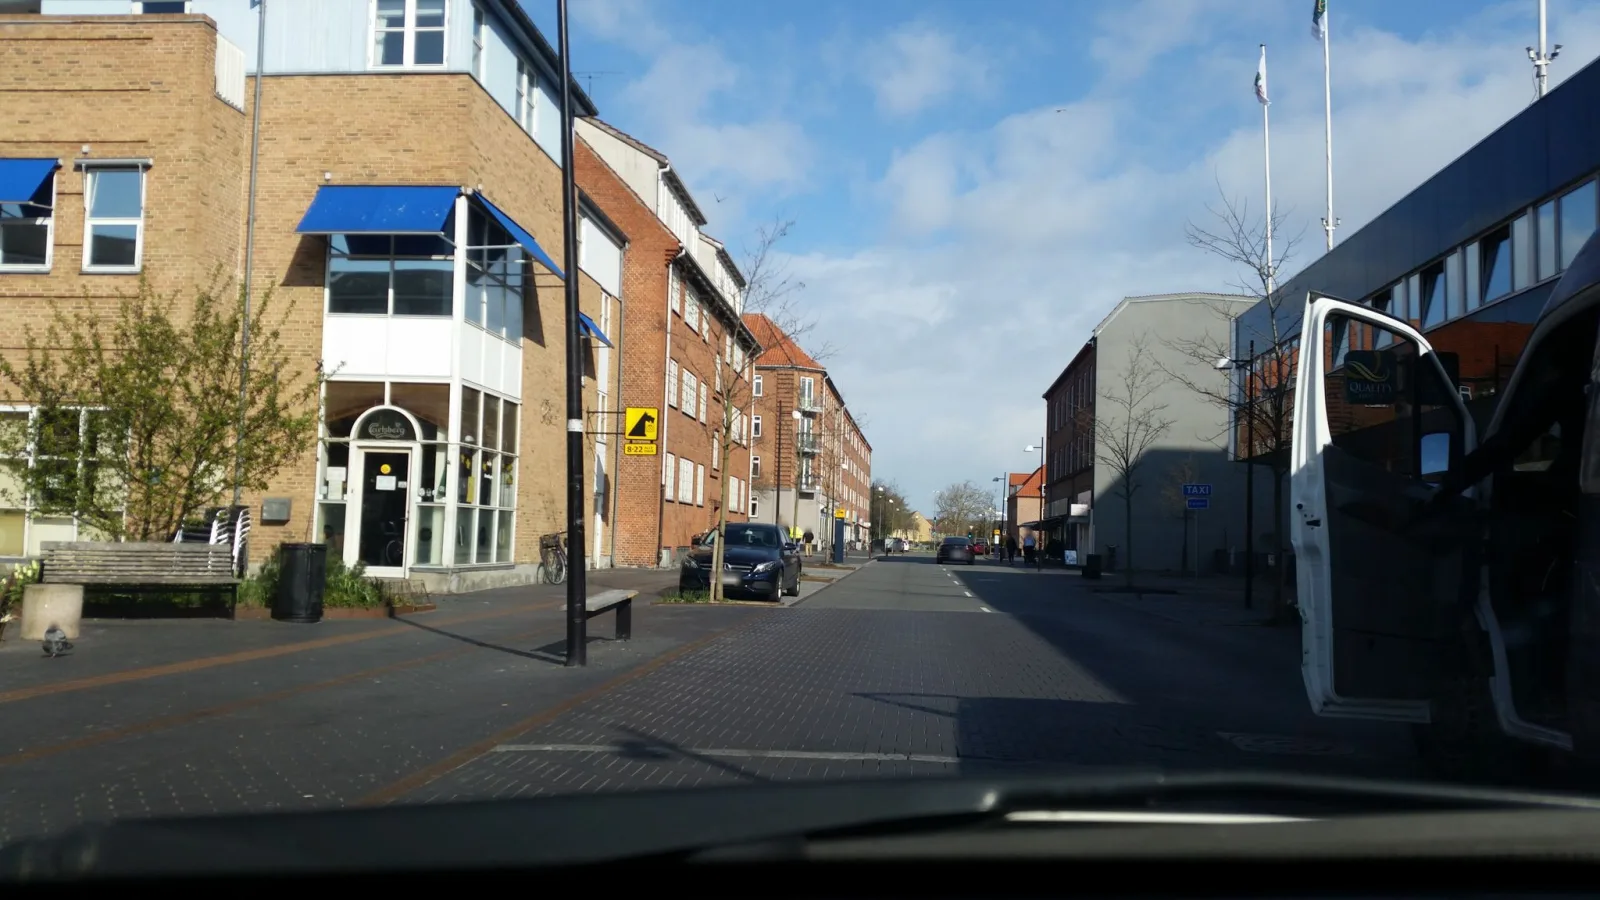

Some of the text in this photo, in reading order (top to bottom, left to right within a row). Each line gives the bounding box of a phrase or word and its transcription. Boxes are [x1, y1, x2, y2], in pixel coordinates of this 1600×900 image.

[1350, 382, 1392, 393] QUALITY
[368, 423, 405, 438] Carlsberg
[1186, 486, 1209, 494] TAXI
